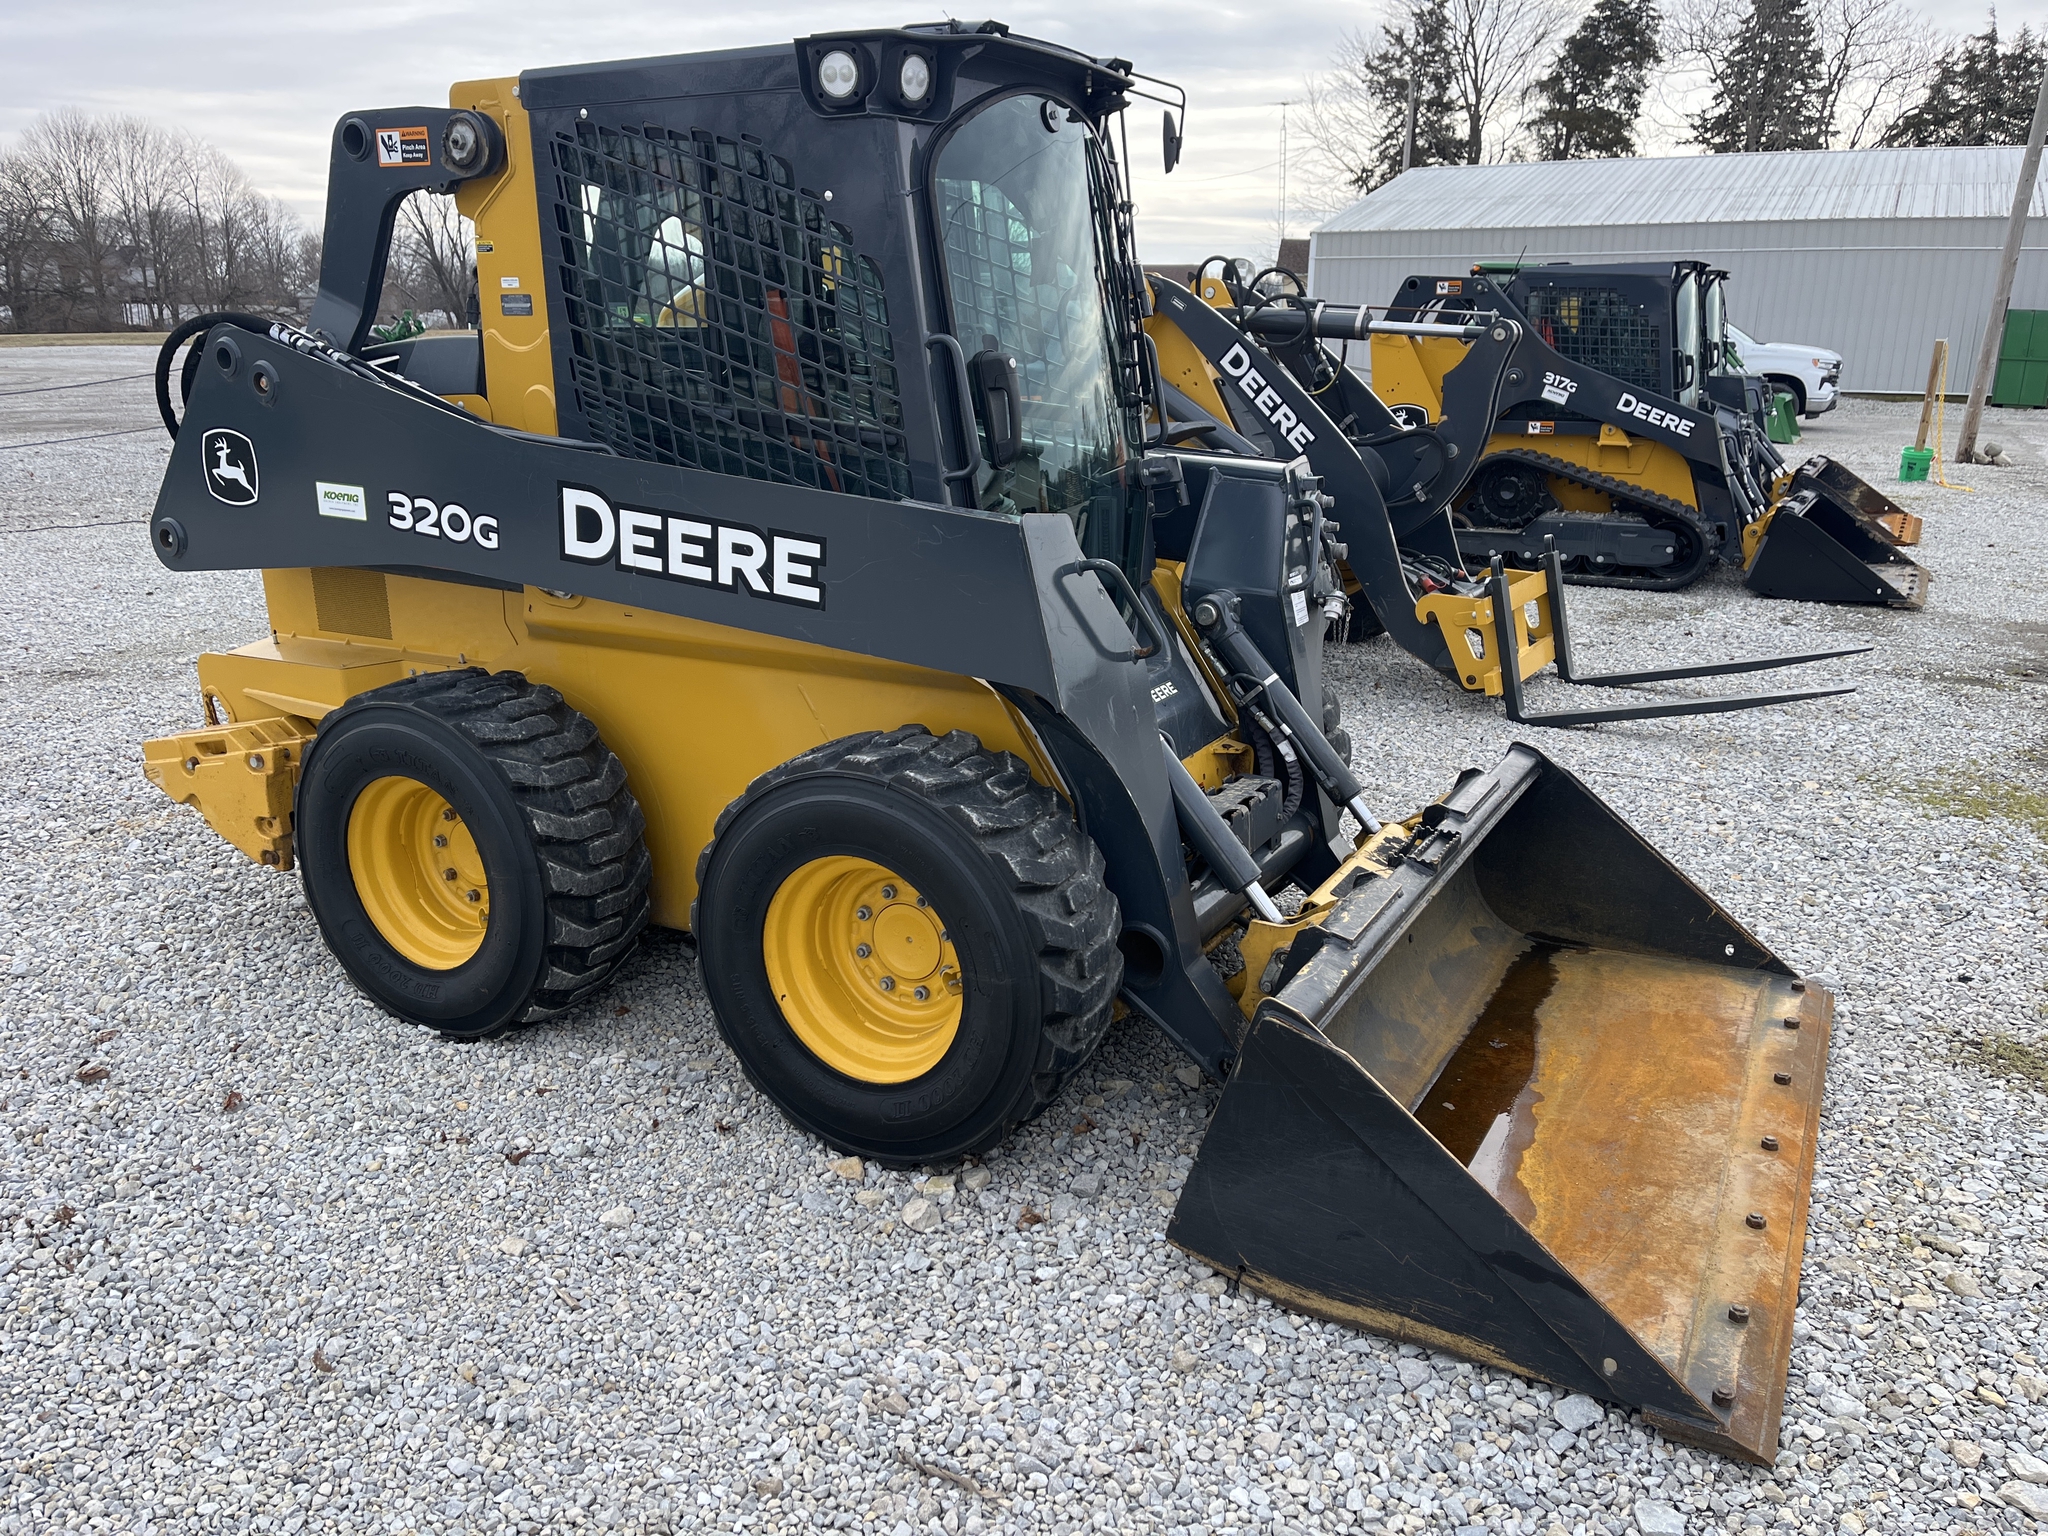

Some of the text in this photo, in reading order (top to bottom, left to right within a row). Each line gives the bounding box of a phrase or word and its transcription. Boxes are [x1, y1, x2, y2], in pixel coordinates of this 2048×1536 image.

[1220, 342, 1316, 454] DEERE
[1542, 371, 1578, 393] 317G
[1616, 392, 1696, 438] DEERE
[388, 492, 499, 549] 320G
[562, 487, 821, 603] DEERE
[1150, 681, 1179, 703] EERE
